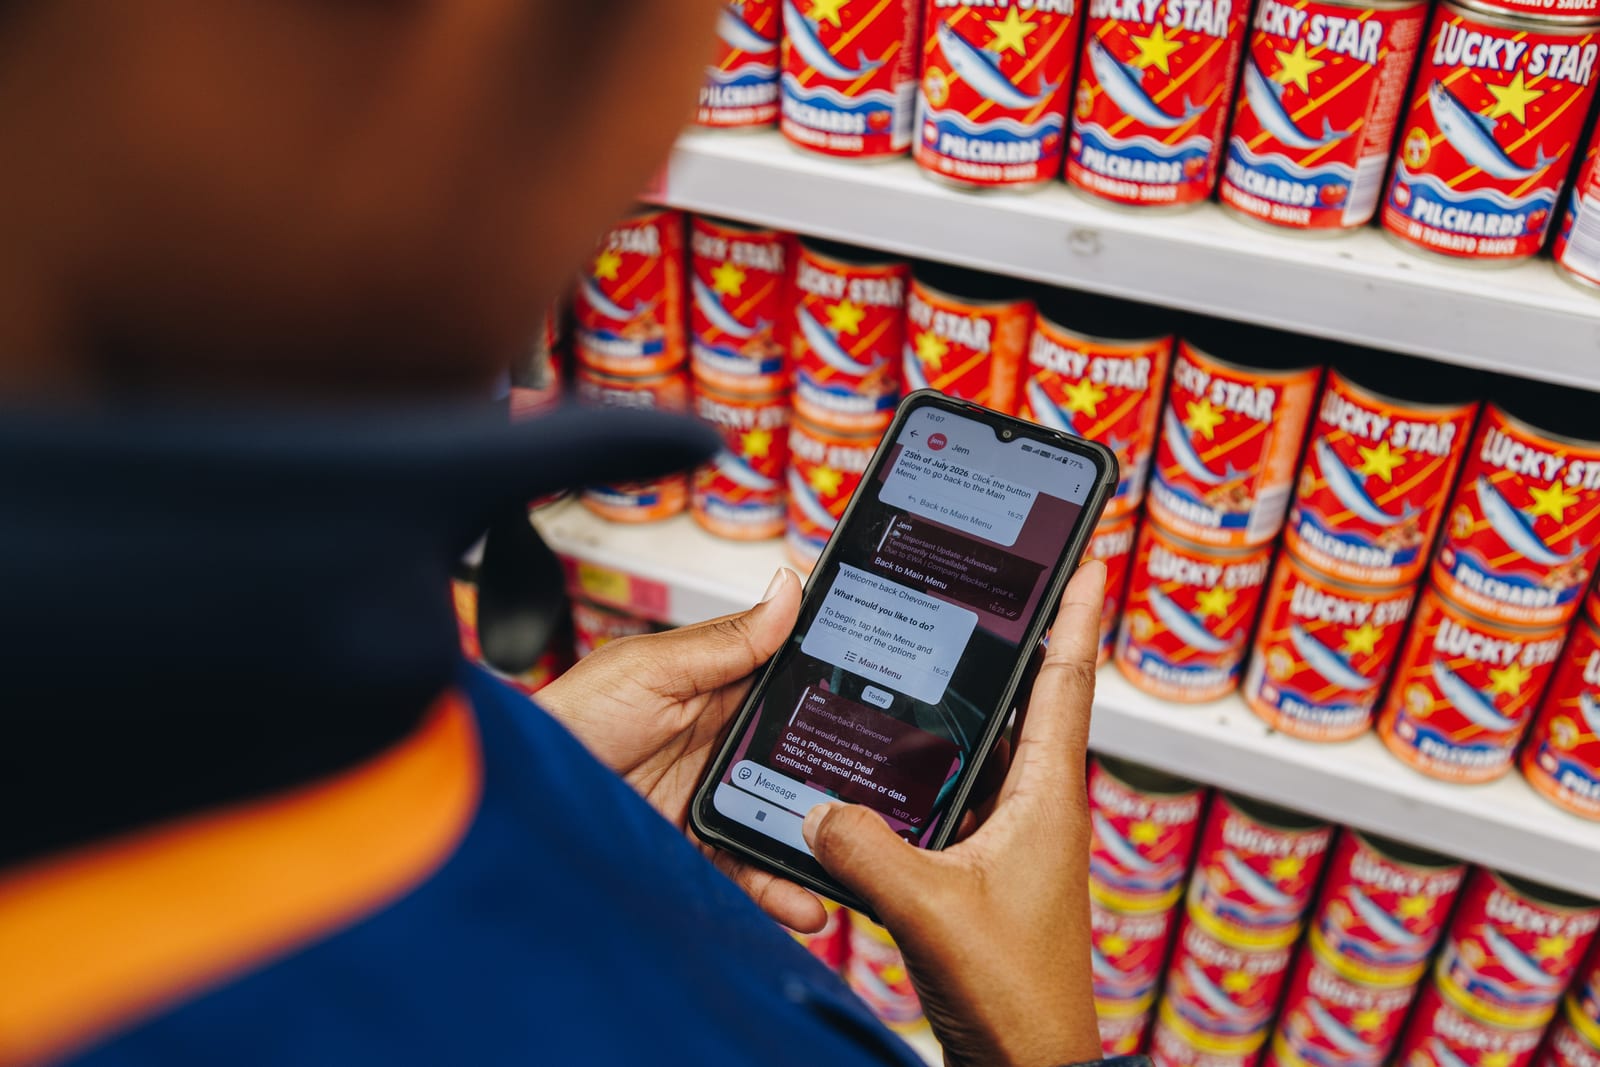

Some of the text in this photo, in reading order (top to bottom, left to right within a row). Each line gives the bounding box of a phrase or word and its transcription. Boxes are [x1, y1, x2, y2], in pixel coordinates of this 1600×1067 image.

[1164, 0, 1233, 39] STAR
[1307, 14, 1383, 65] STAR
[1432, 20, 1599, 87] LUCKY STAR
[1082, 145, 1183, 184] PILCHARDS
[1225, 156, 1318, 208] PILCHARDS
[1412, 196, 1526, 237] PILCHARDS
[1423, 229, 1478, 252] TOMATO
[1478, 238, 1518, 255] SAUCE
[1091, 355, 1152, 391] STAR
[1211, 377, 1276, 423] STAR
[1320, 389, 1457, 457] LUCKY STAR
[952, 444, 970, 455] Jem
[1480, 426, 1566, 481] LUCKY
[896, 467, 918, 480] Menu.
[900, 459, 922, 471] below
[923, 467, 931, 475] to
[932, 471, 943, 479] go
[943, 474, 962, 485] back
[972, 484, 985, 493] the
[986, 489, 1006, 500] Main
[904, 450, 922, 461] 25th
[932, 459, 949, 471] July
[972, 473, 991, 485] Click
[992, 480, 1005, 489] the
[1006, 486, 1032, 499] button
[896, 520, 913, 531] Jem
[919, 498, 993, 530] Back to Main Menu
[874, 556, 948, 590] Back to Main Menu
[889, 538, 968, 572] Temporarily Unavailable
[902, 533, 936, 551] Important
[963, 556, 998, 573] Advances
[927, 561, 960, 579] Company
[833, 587, 935, 632] What would you like to do?
[843, 568, 941, 612] Welcome back Chevonne!
[1290, 582, 1371, 625] LUCKY
[819, 617, 917, 661] choose one of the options
[824, 606, 933, 655] To begin, tap Main Menu and
[1434, 617, 1522, 666] LUCKY
[858, 656, 902, 680] Main Menu
[809, 693, 826, 705] Jem
[868, 690, 888, 704] Today
[796, 720, 815, 733] What
[815, 728, 836, 742] would
[836, 738, 851, 748] you
[851, 742, 864, 754] like
[864, 749, 873, 758] to
[805, 702, 893, 744] Welcome back Chevonne!
[775, 753, 814, 776] contracts.
[786, 732, 801, 745] Get
[807, 742, 854, 767] Phone/Data
[854, 761, 875, 776] Deal
[758, 776, 798, 801] Message
[807, 753, 822, 766] Get
[821, 761, 852, 779] special
[850, 773, 878, 790] phone
[877, 784, 889, 794] or
[888, 788, 907, 803] data
